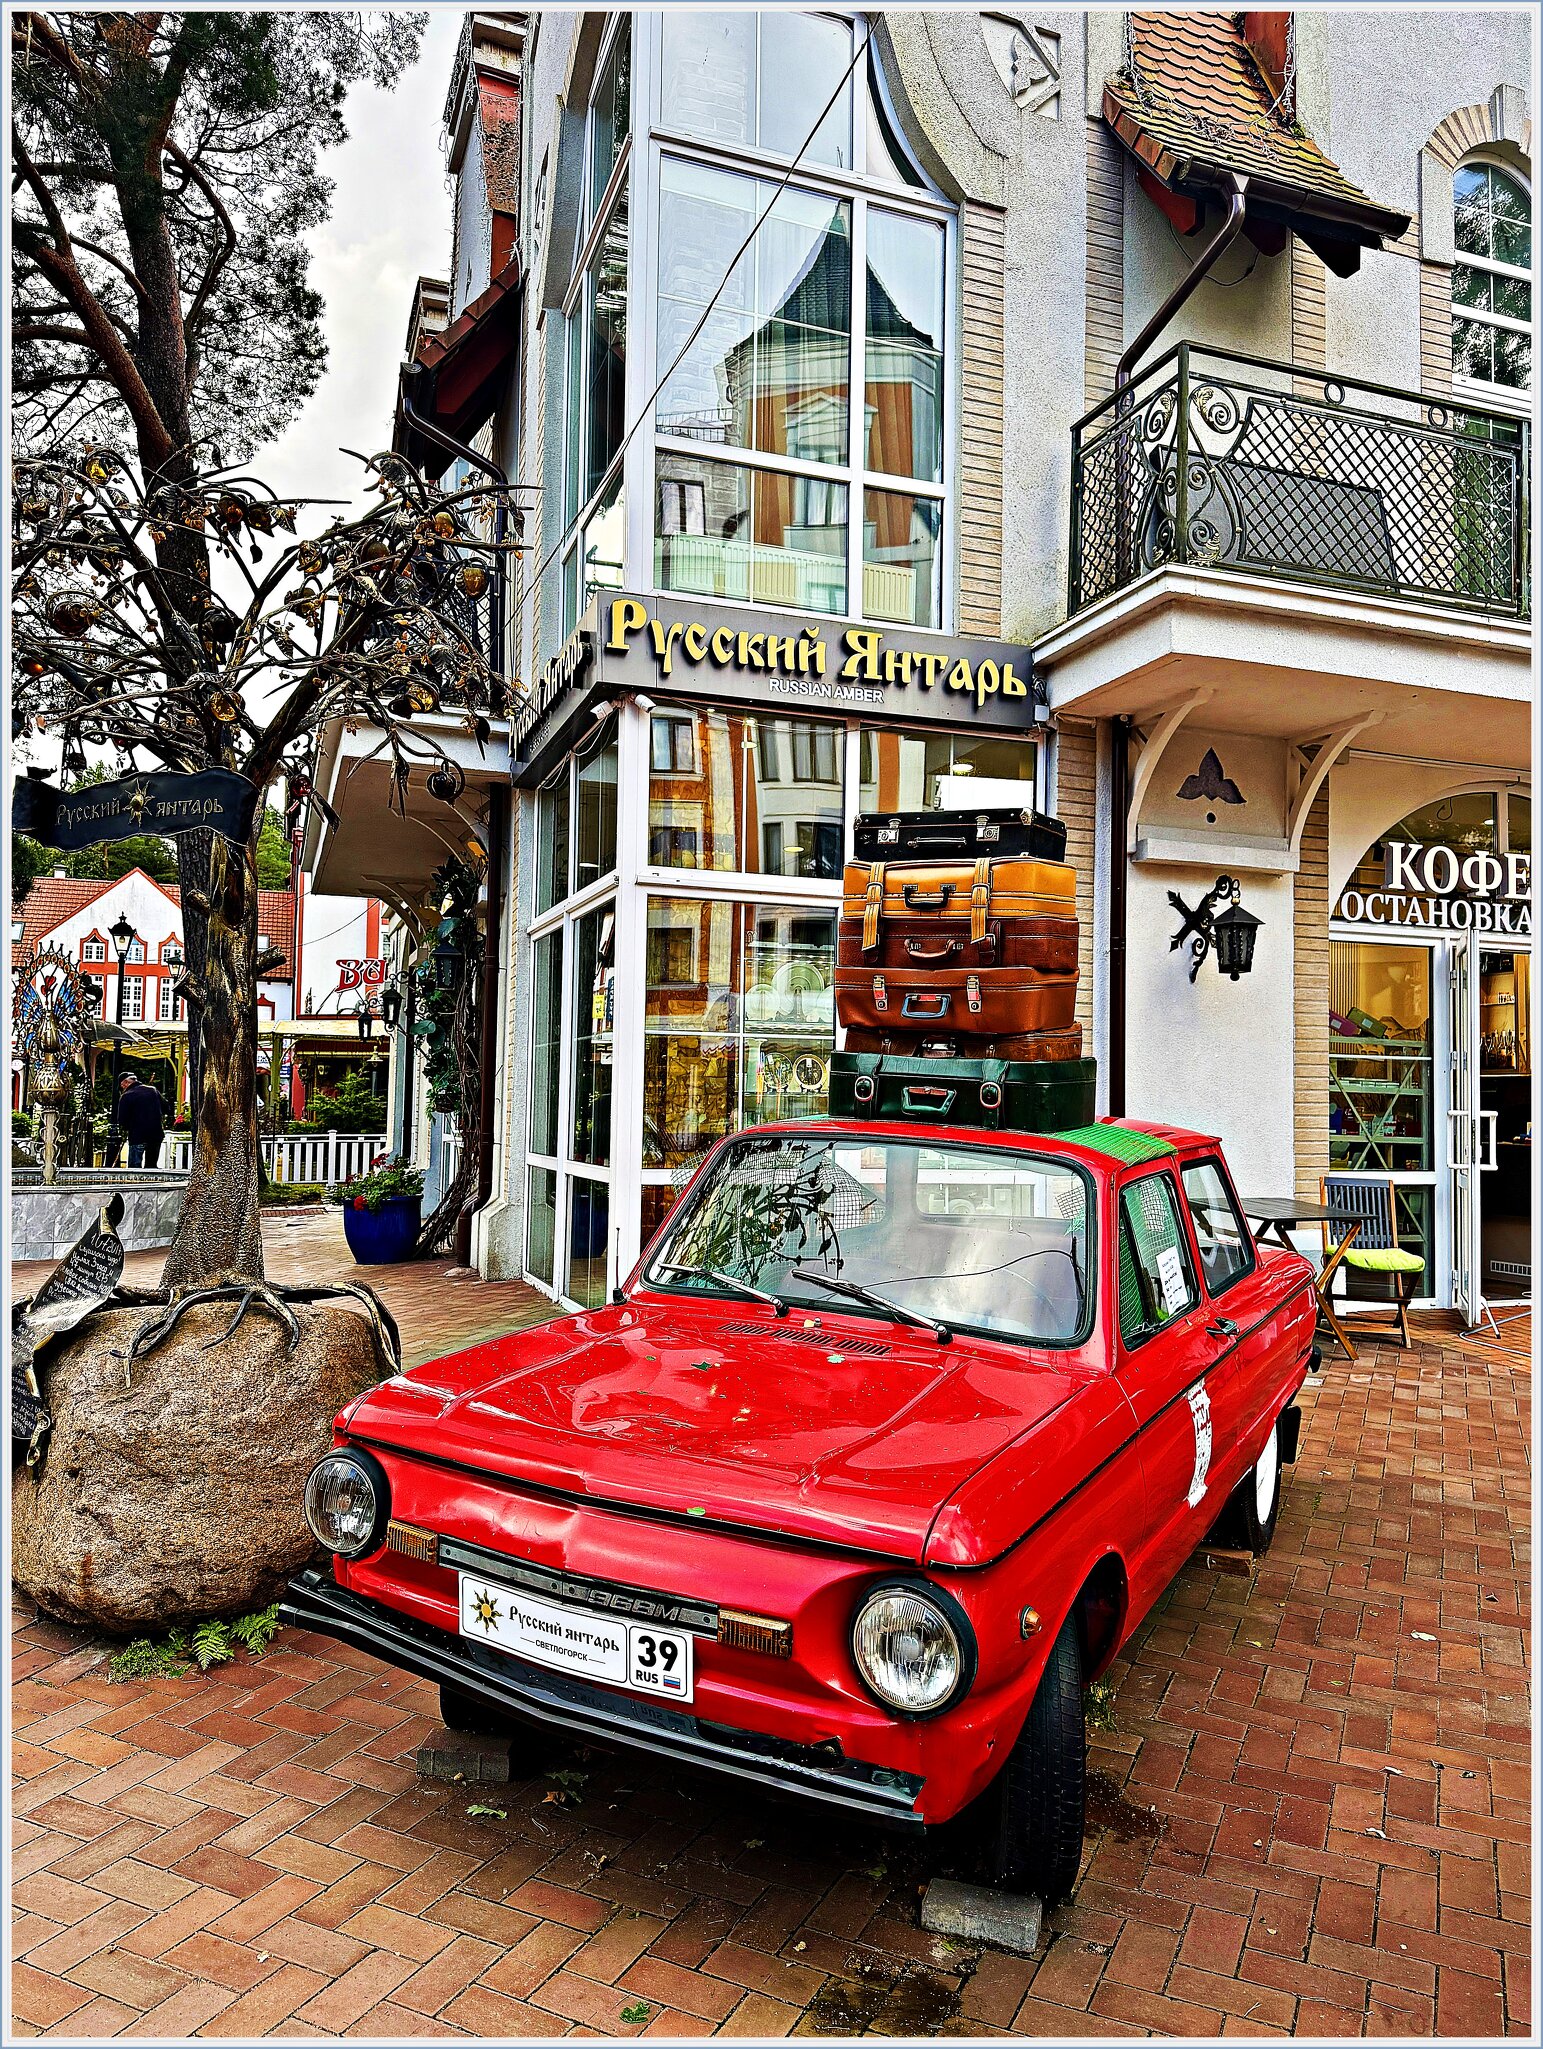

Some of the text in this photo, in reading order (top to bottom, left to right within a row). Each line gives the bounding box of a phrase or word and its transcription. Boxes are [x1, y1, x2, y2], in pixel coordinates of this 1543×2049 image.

[606, 599, 1029, 708] Русский Янтарь
[769, 678, 885, 704] RUSSIAN AMBER
[56, 797, 121, 830] Русский
[1387, 841, 1532, 900] КОФЕ
[1340, 891, 1532, 934] ОСТАНОВКА
[508, 1604, 620, 1655] Русский янтарь
[534, 1638, 589, 1663] СВЕТЛОГОРСК
[637, 1634, 679, 1673] 39
[635, 1668, 659, 1685] RUS
